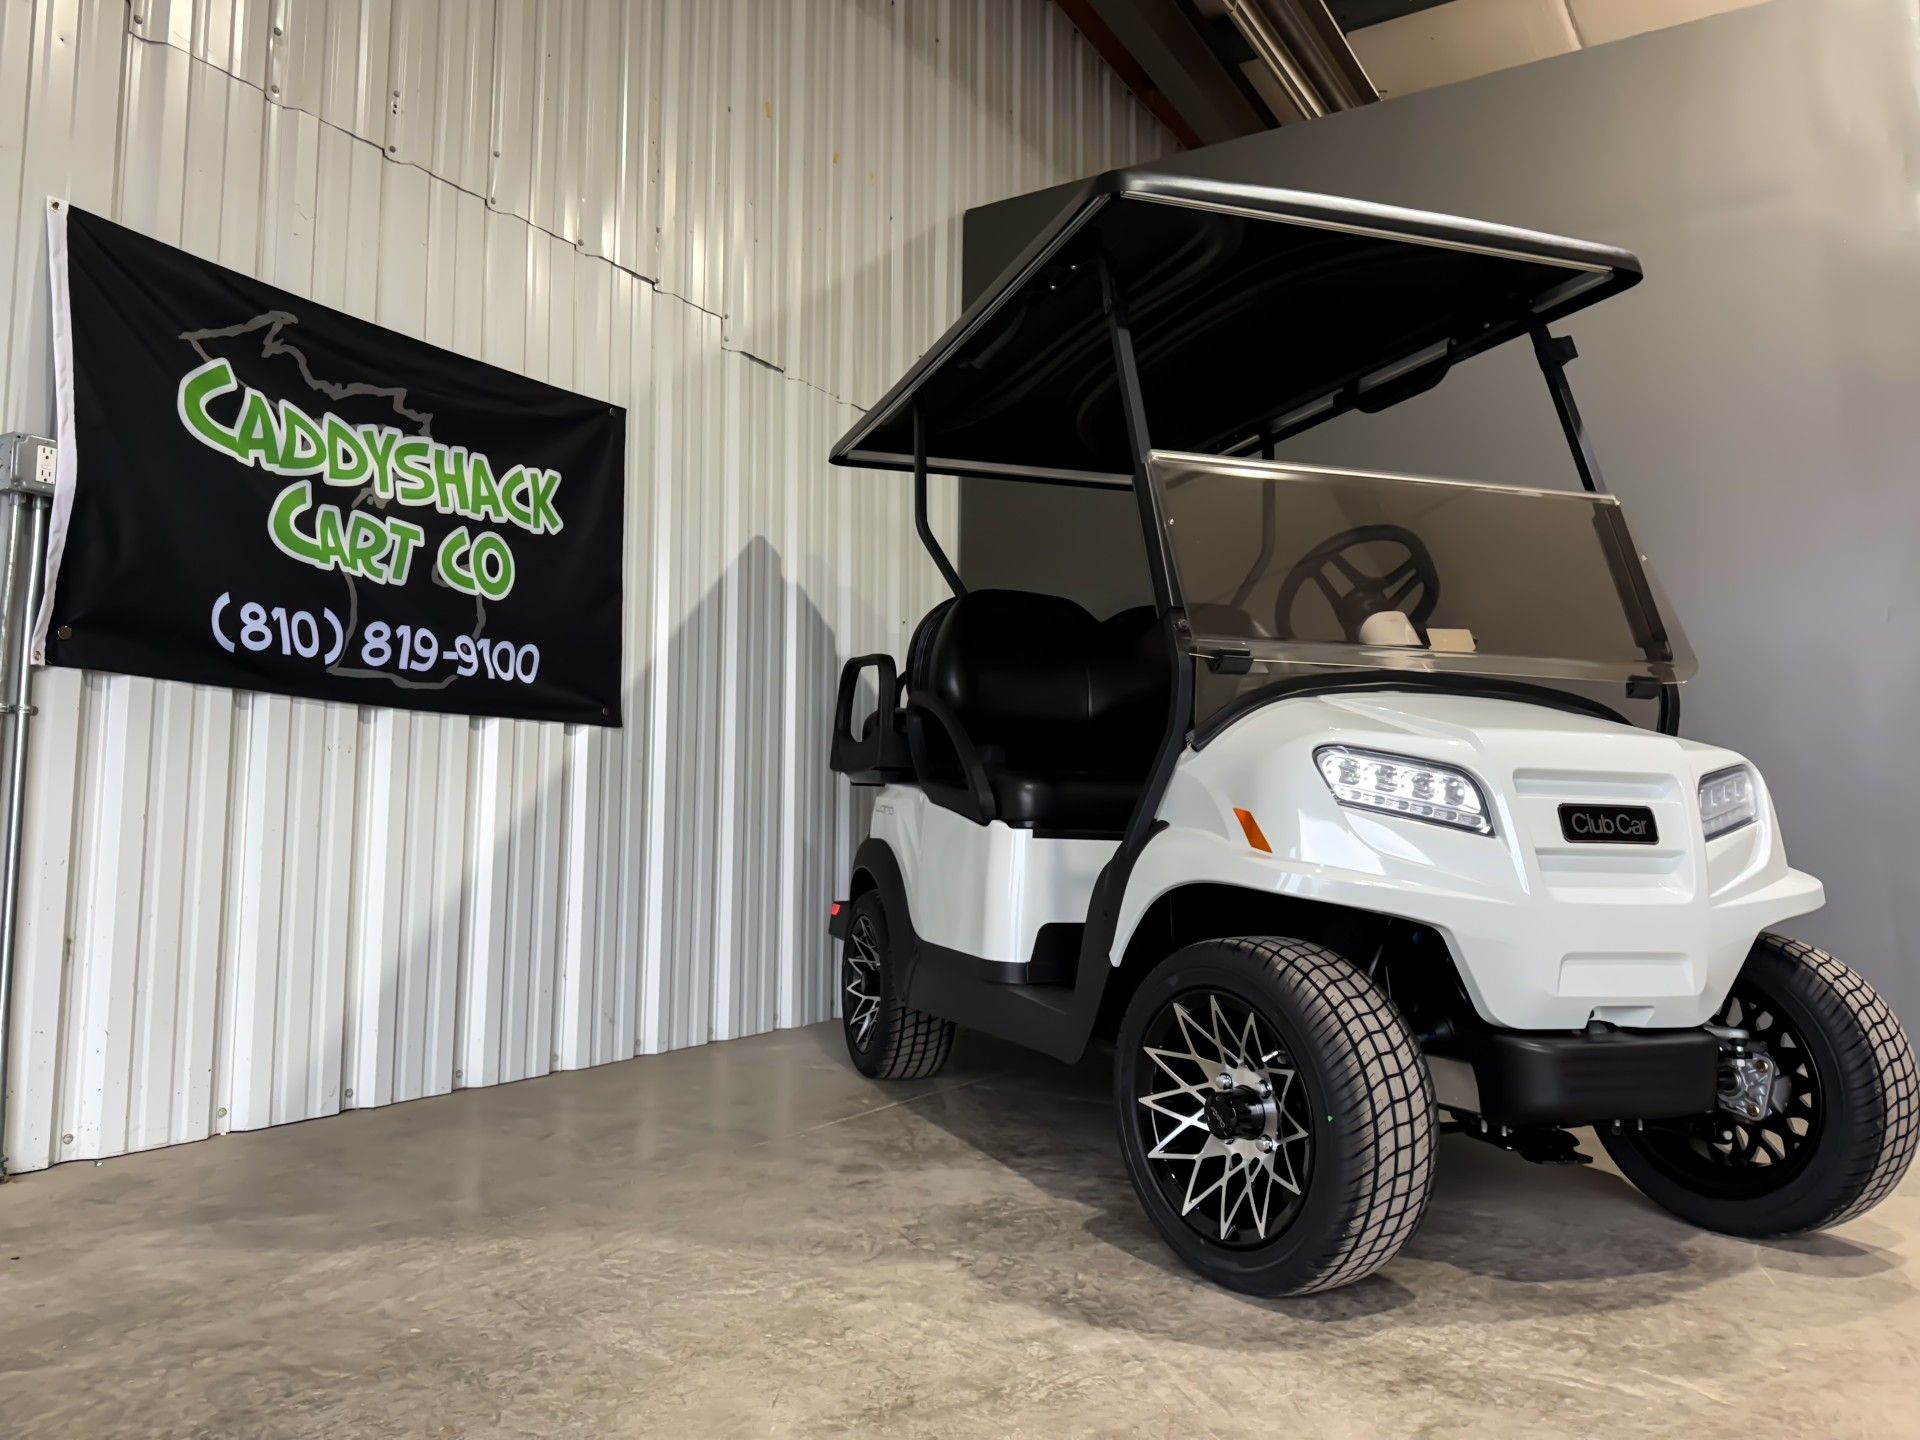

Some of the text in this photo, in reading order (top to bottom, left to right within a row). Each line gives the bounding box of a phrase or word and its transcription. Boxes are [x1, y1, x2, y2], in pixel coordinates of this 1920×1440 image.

[177, 358, 563, 535] CADDYSHACK
[268, 480, 516, 600] CART CO
[211, 591, 540, 684] (810) 819-9100
[1571, 812, 1647, 835] Club Car
